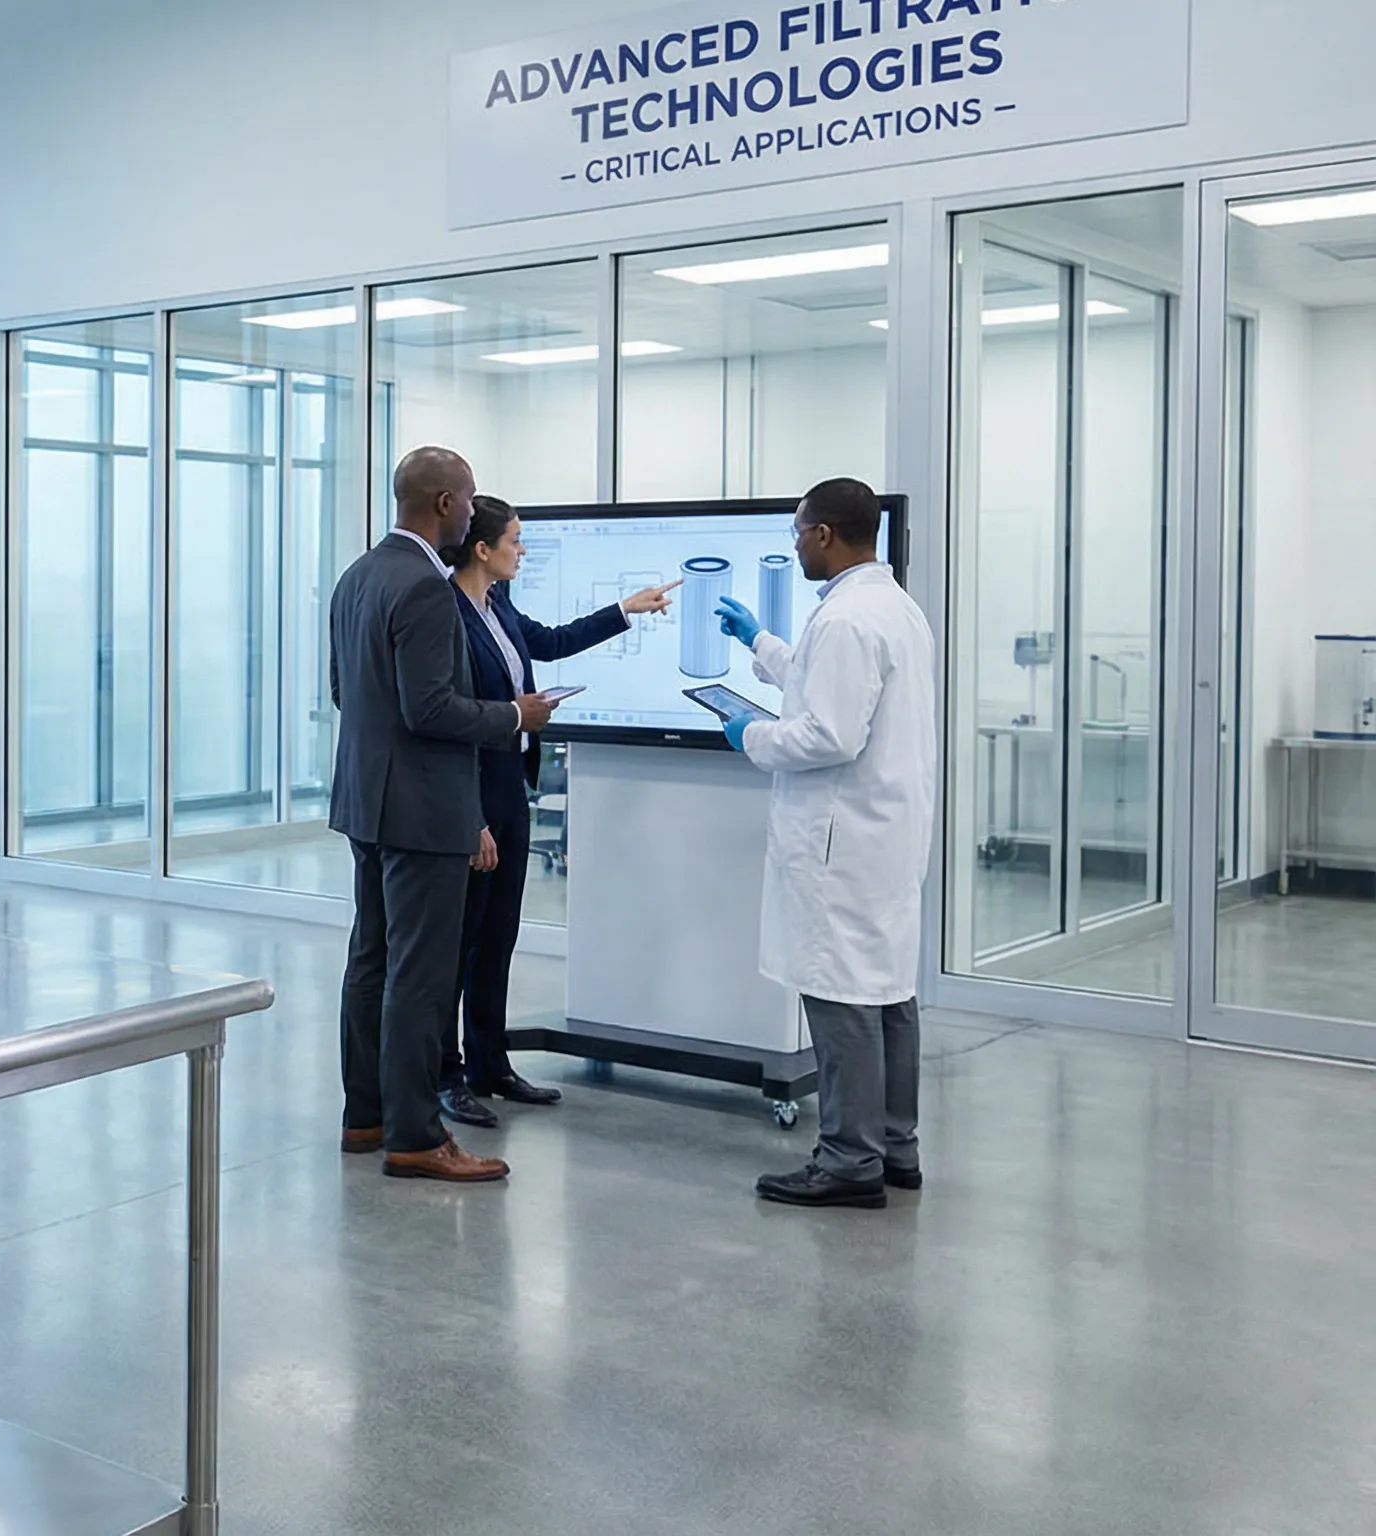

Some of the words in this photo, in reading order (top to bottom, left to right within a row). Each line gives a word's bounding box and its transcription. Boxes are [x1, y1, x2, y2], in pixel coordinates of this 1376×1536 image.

[485, 20, 759, 108] ADVANCED
[571, 30, 1003, 143] TECHNOLOGIES
[585, 142, 721, 183] CRITICAL
[731, 98, 982, 162] APPLICATIONS
